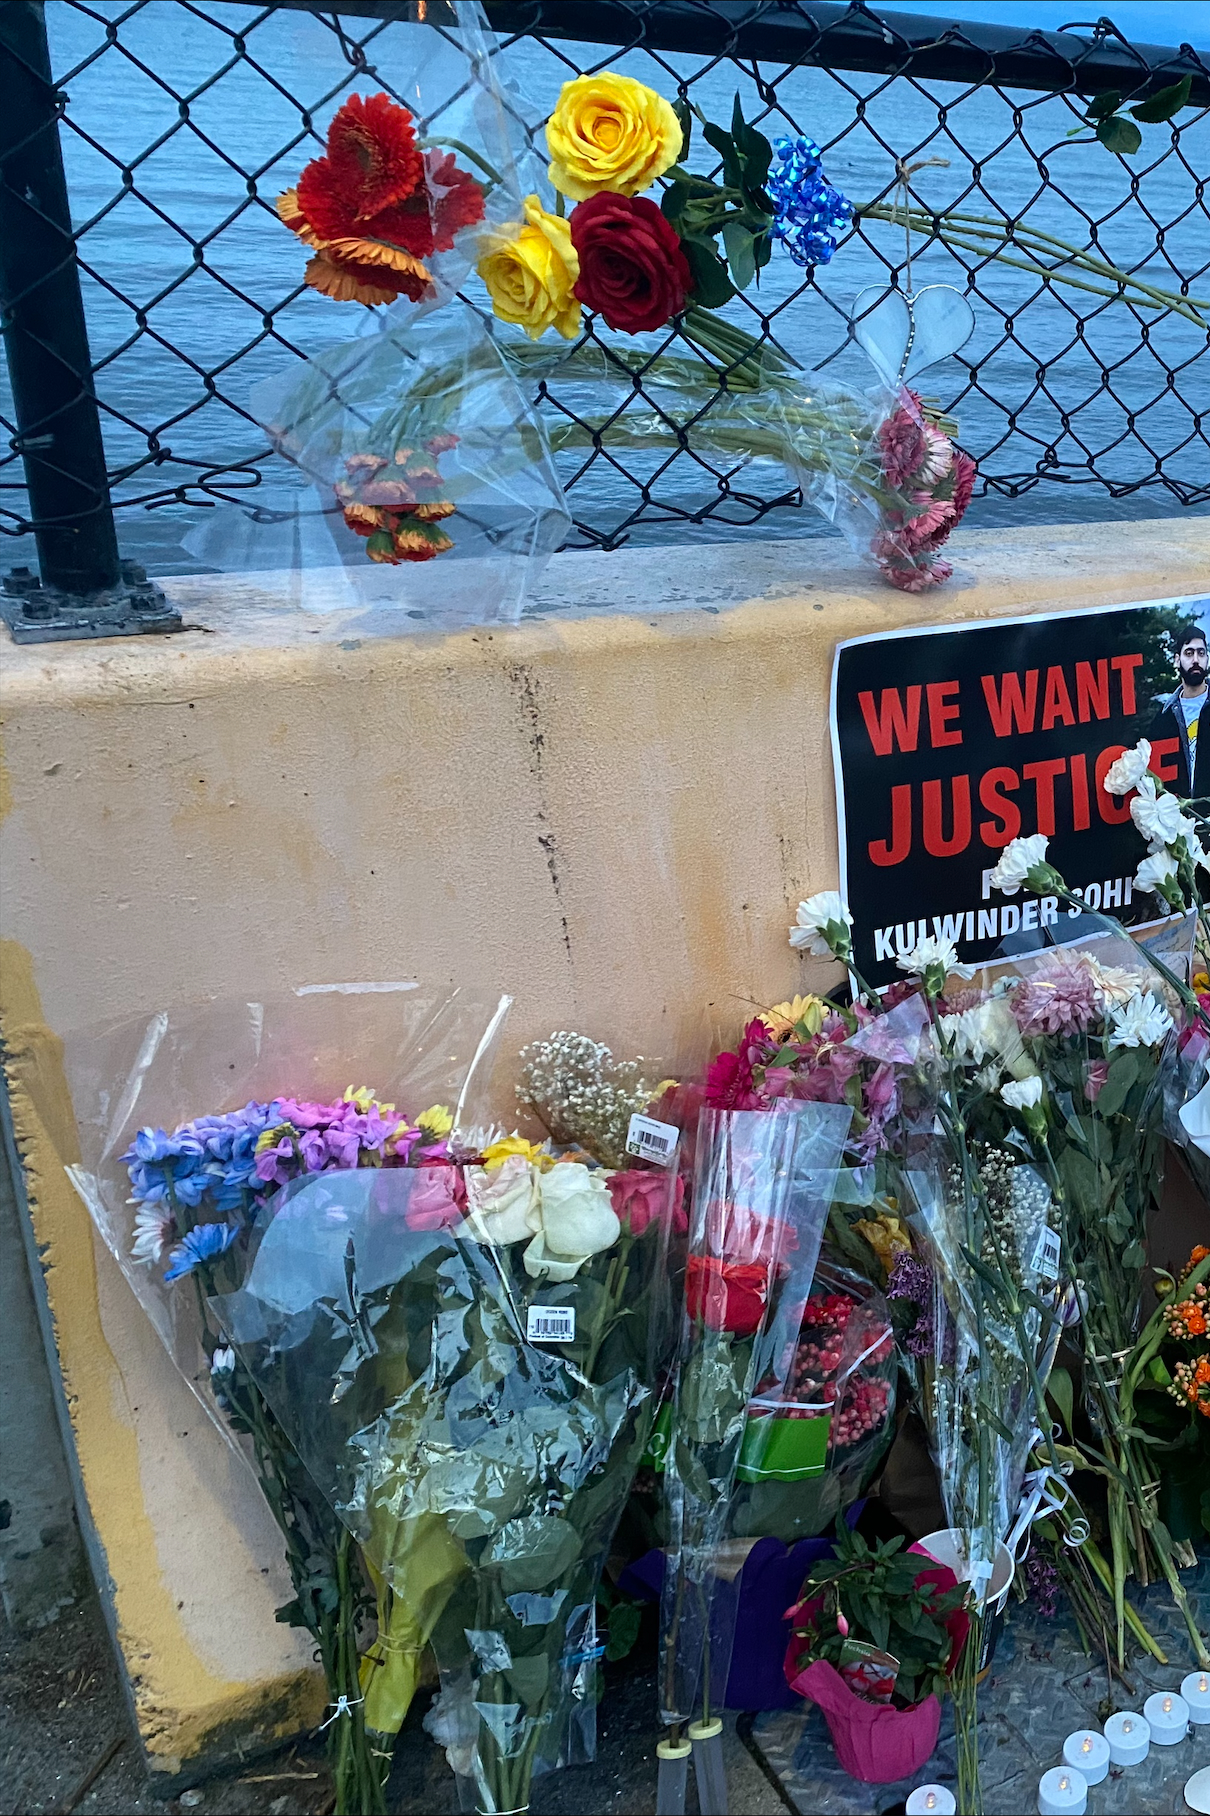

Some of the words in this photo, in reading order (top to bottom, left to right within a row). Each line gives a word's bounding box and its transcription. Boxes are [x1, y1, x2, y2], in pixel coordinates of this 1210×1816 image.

[858, 680, 963, 756] WE
[981, 653, 1143, 738] WANT
[1067, 876, 1133, 919] SOHI
